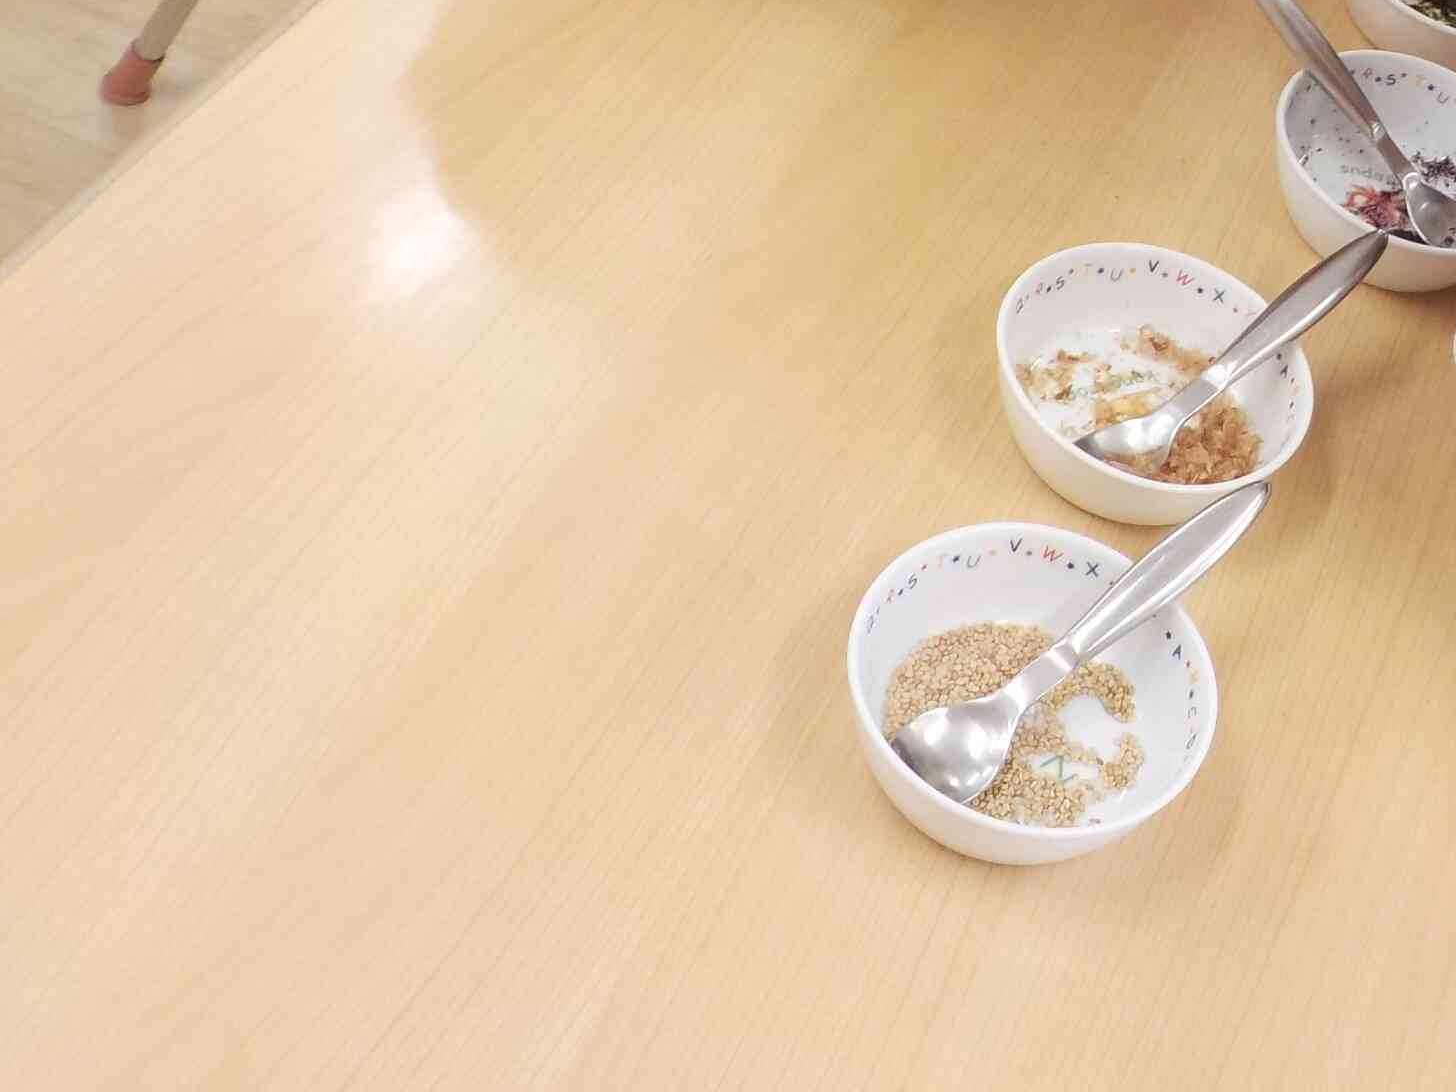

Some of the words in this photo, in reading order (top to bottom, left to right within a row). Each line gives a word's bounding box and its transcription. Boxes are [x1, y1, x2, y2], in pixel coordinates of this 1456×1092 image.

[1386, 73, 1397, 86] S
[1436, 91, 1449, 105] U
[1055, 276, 1066, 290] S
[1110, 267, 1124, 282] U
[1147, 259, 1160, 273] V
[1175, 269, 1194, 286] W
[1213, 289, 1226, 304] X
[907, 575, 919, 590] S
[965, 553, 982, 568] U
[1008, 537, 1023, 554] V
[1041, 544, 1064, 564] W
[1084, 561, 1100, 579] X
[1171, 643, 1183, 661] A
